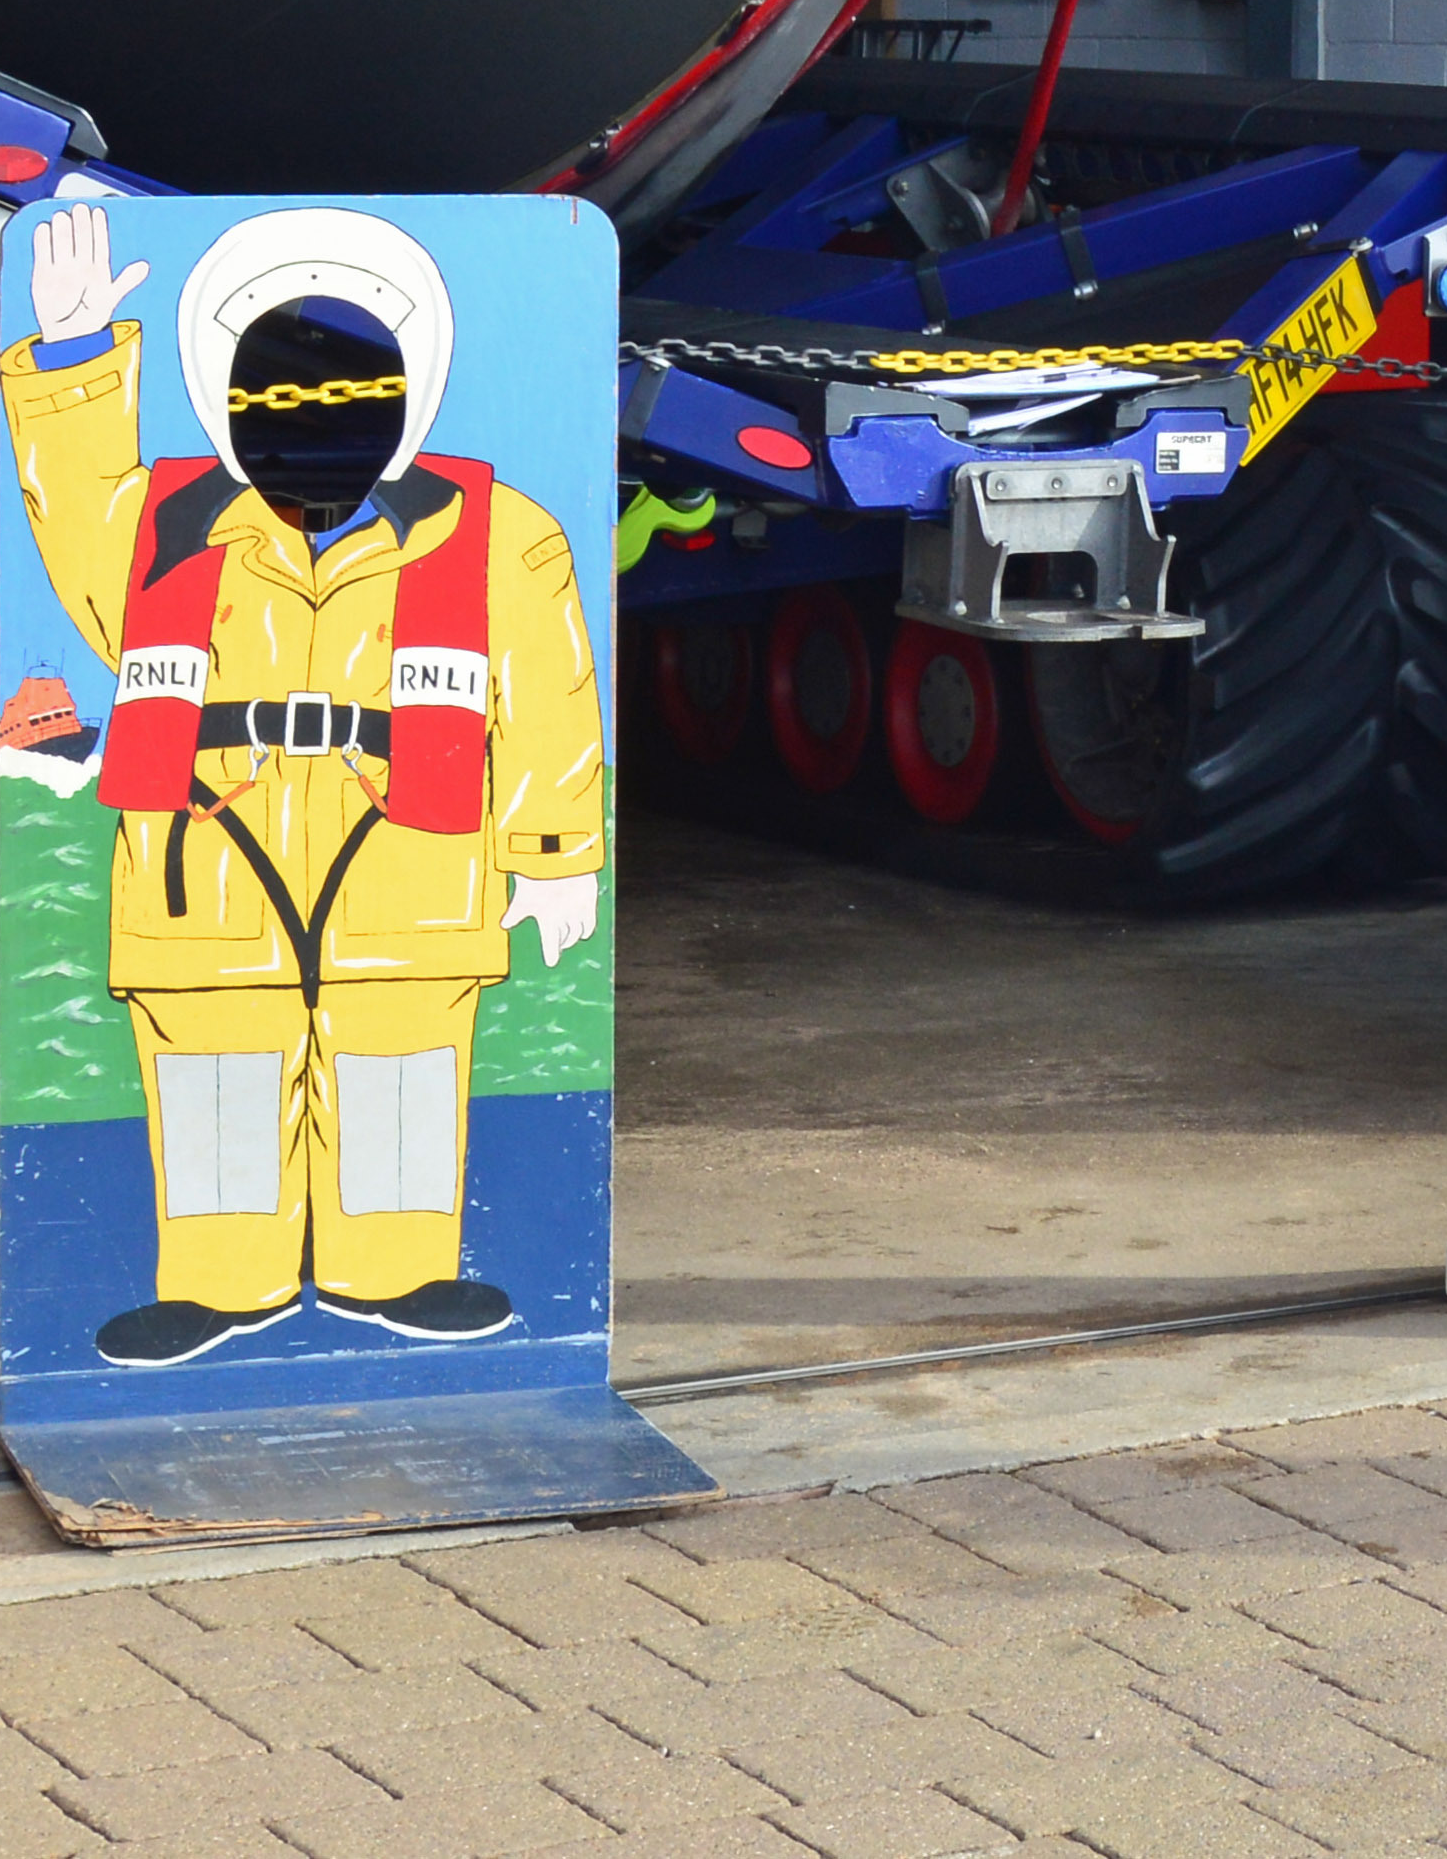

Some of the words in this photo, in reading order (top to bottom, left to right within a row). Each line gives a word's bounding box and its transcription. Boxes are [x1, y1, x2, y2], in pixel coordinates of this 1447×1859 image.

[1298, 278, 1358, 374] HFK
[125, 659, 198, 689] RNLI
[399, 663, 477, 694] RNLI
